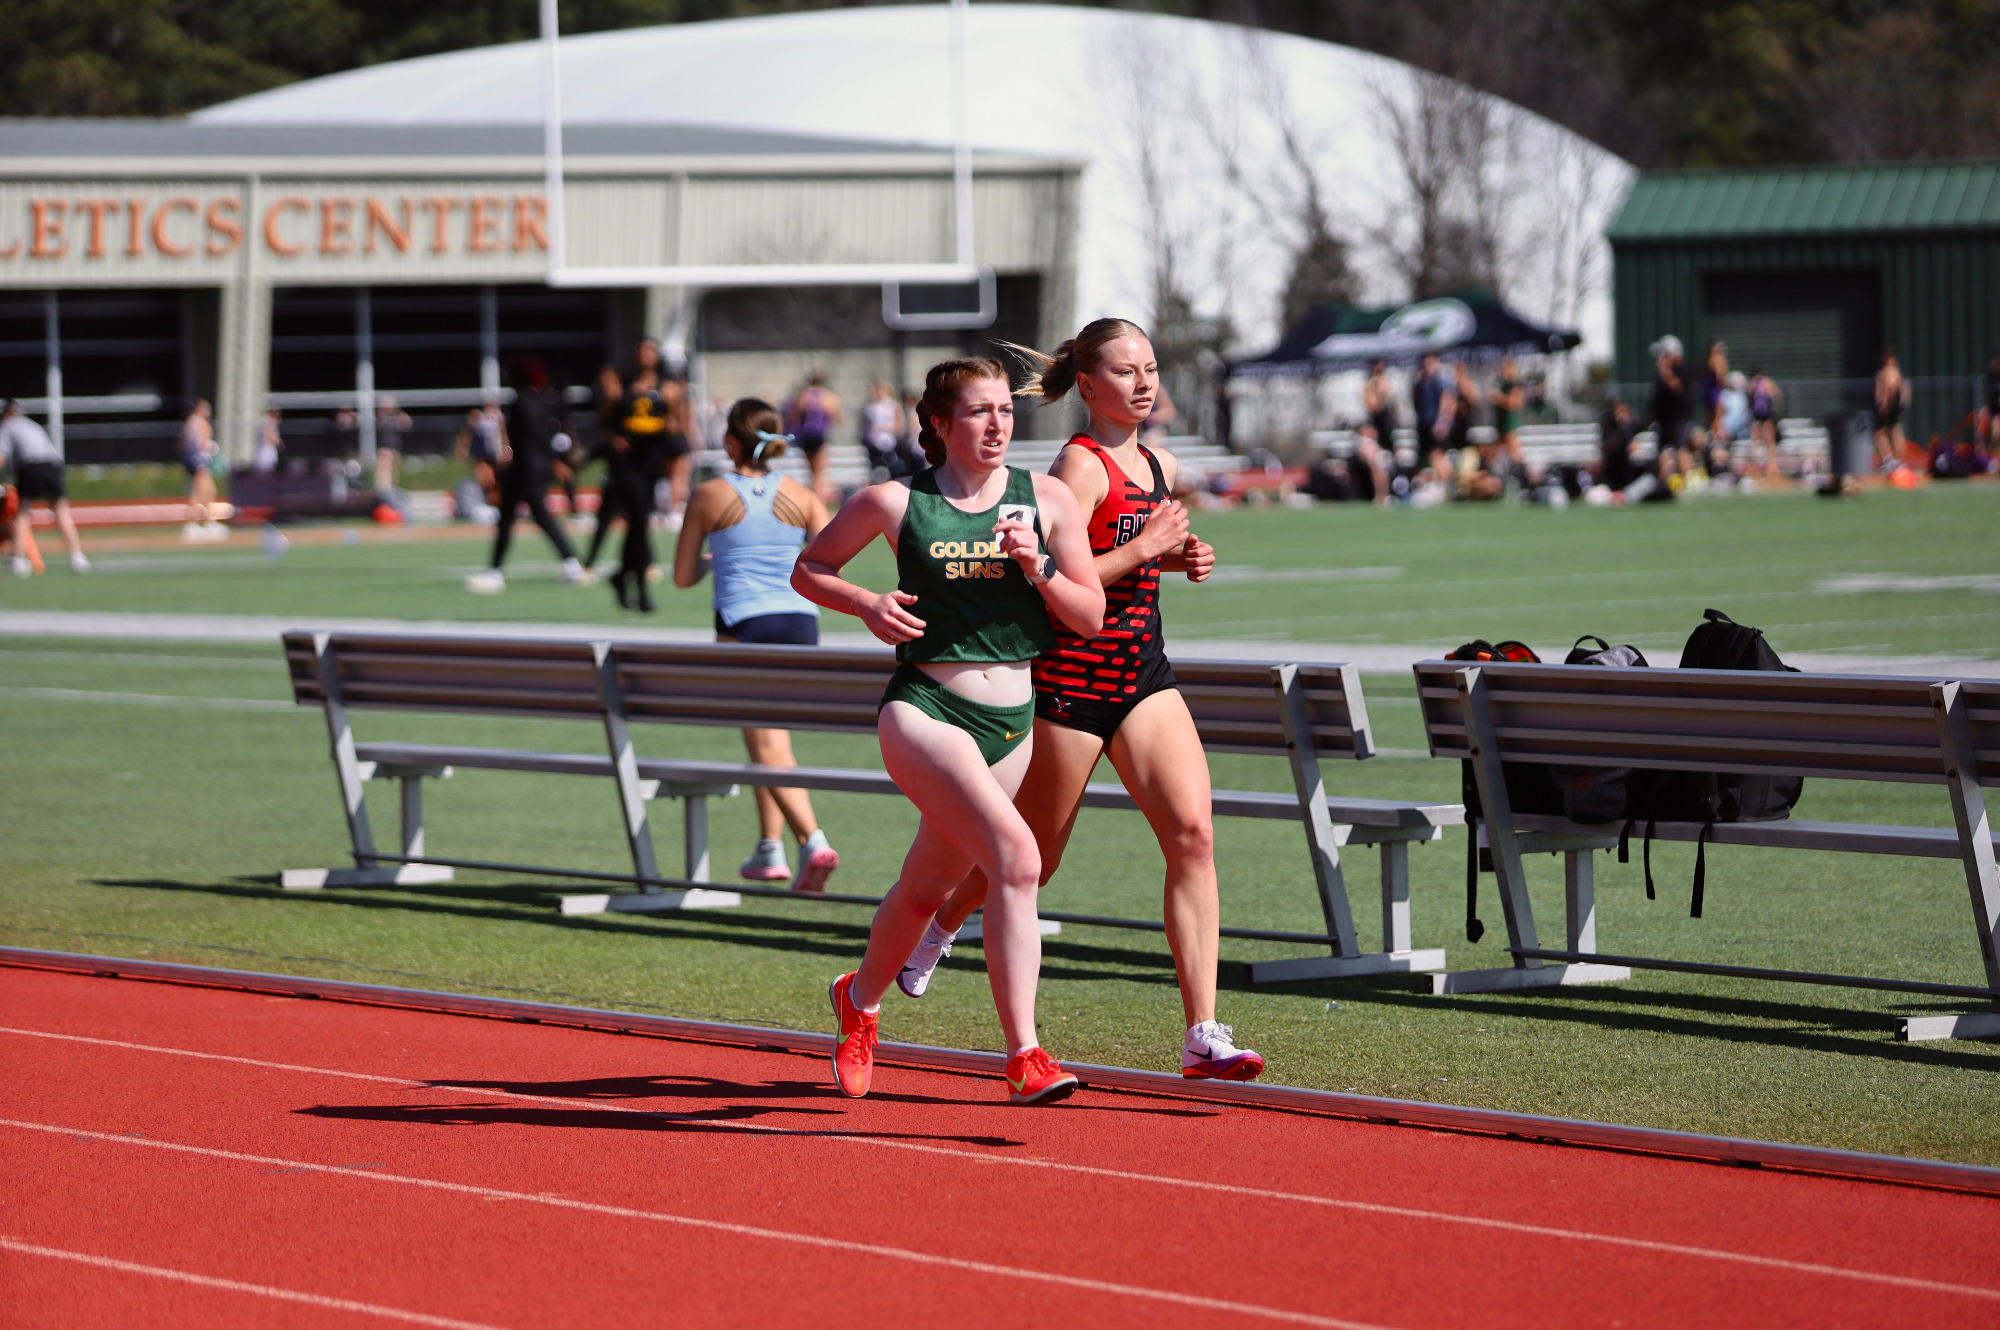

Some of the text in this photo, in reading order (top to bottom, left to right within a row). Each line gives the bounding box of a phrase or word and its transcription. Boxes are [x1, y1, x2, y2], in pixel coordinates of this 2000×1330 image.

[263, 194, 549, 257] CENTER
[930, 541, 1009, 558] GOLDE
[946, 561, 1005, 579] SUNS
